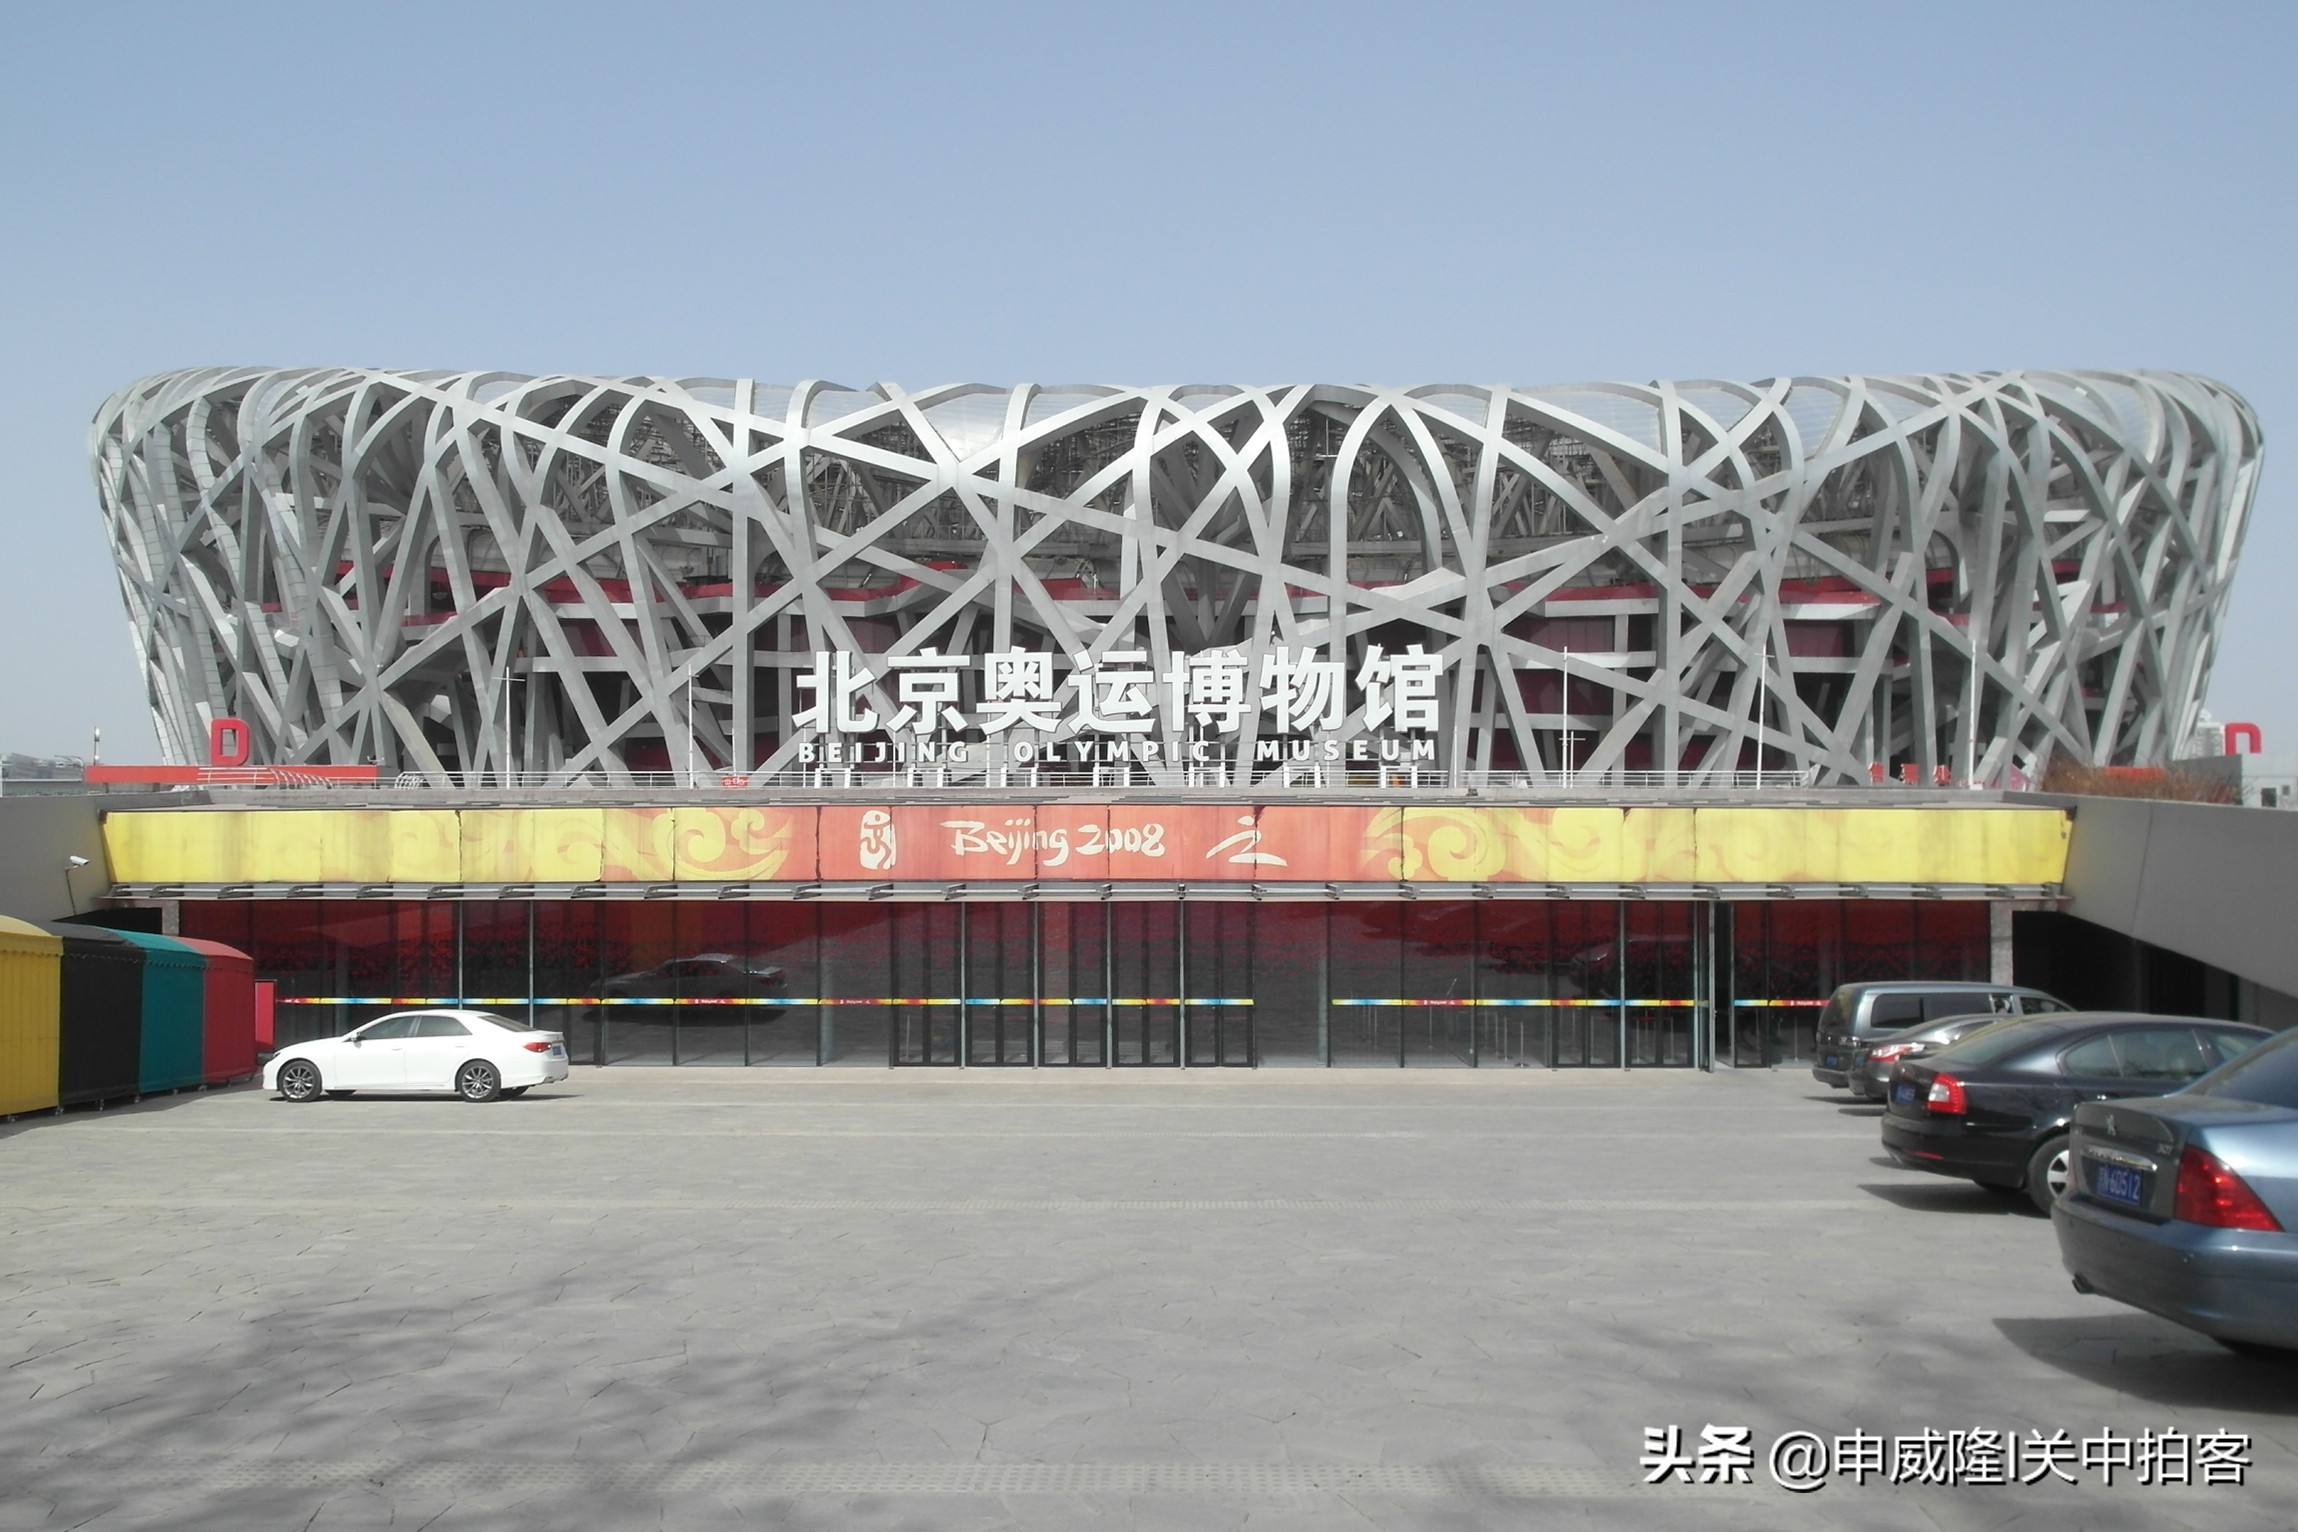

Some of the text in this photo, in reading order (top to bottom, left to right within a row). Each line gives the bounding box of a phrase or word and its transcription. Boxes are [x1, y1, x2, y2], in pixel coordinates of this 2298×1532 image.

[792, 645, 1443, 735] 北京奥运博物馆
[211, 718, 250, 766] D
[799, 740, 1435, 763] BEIJING OLYMPIC MUSEUM
[940, 819, 1165, 866] Beijing 2008
